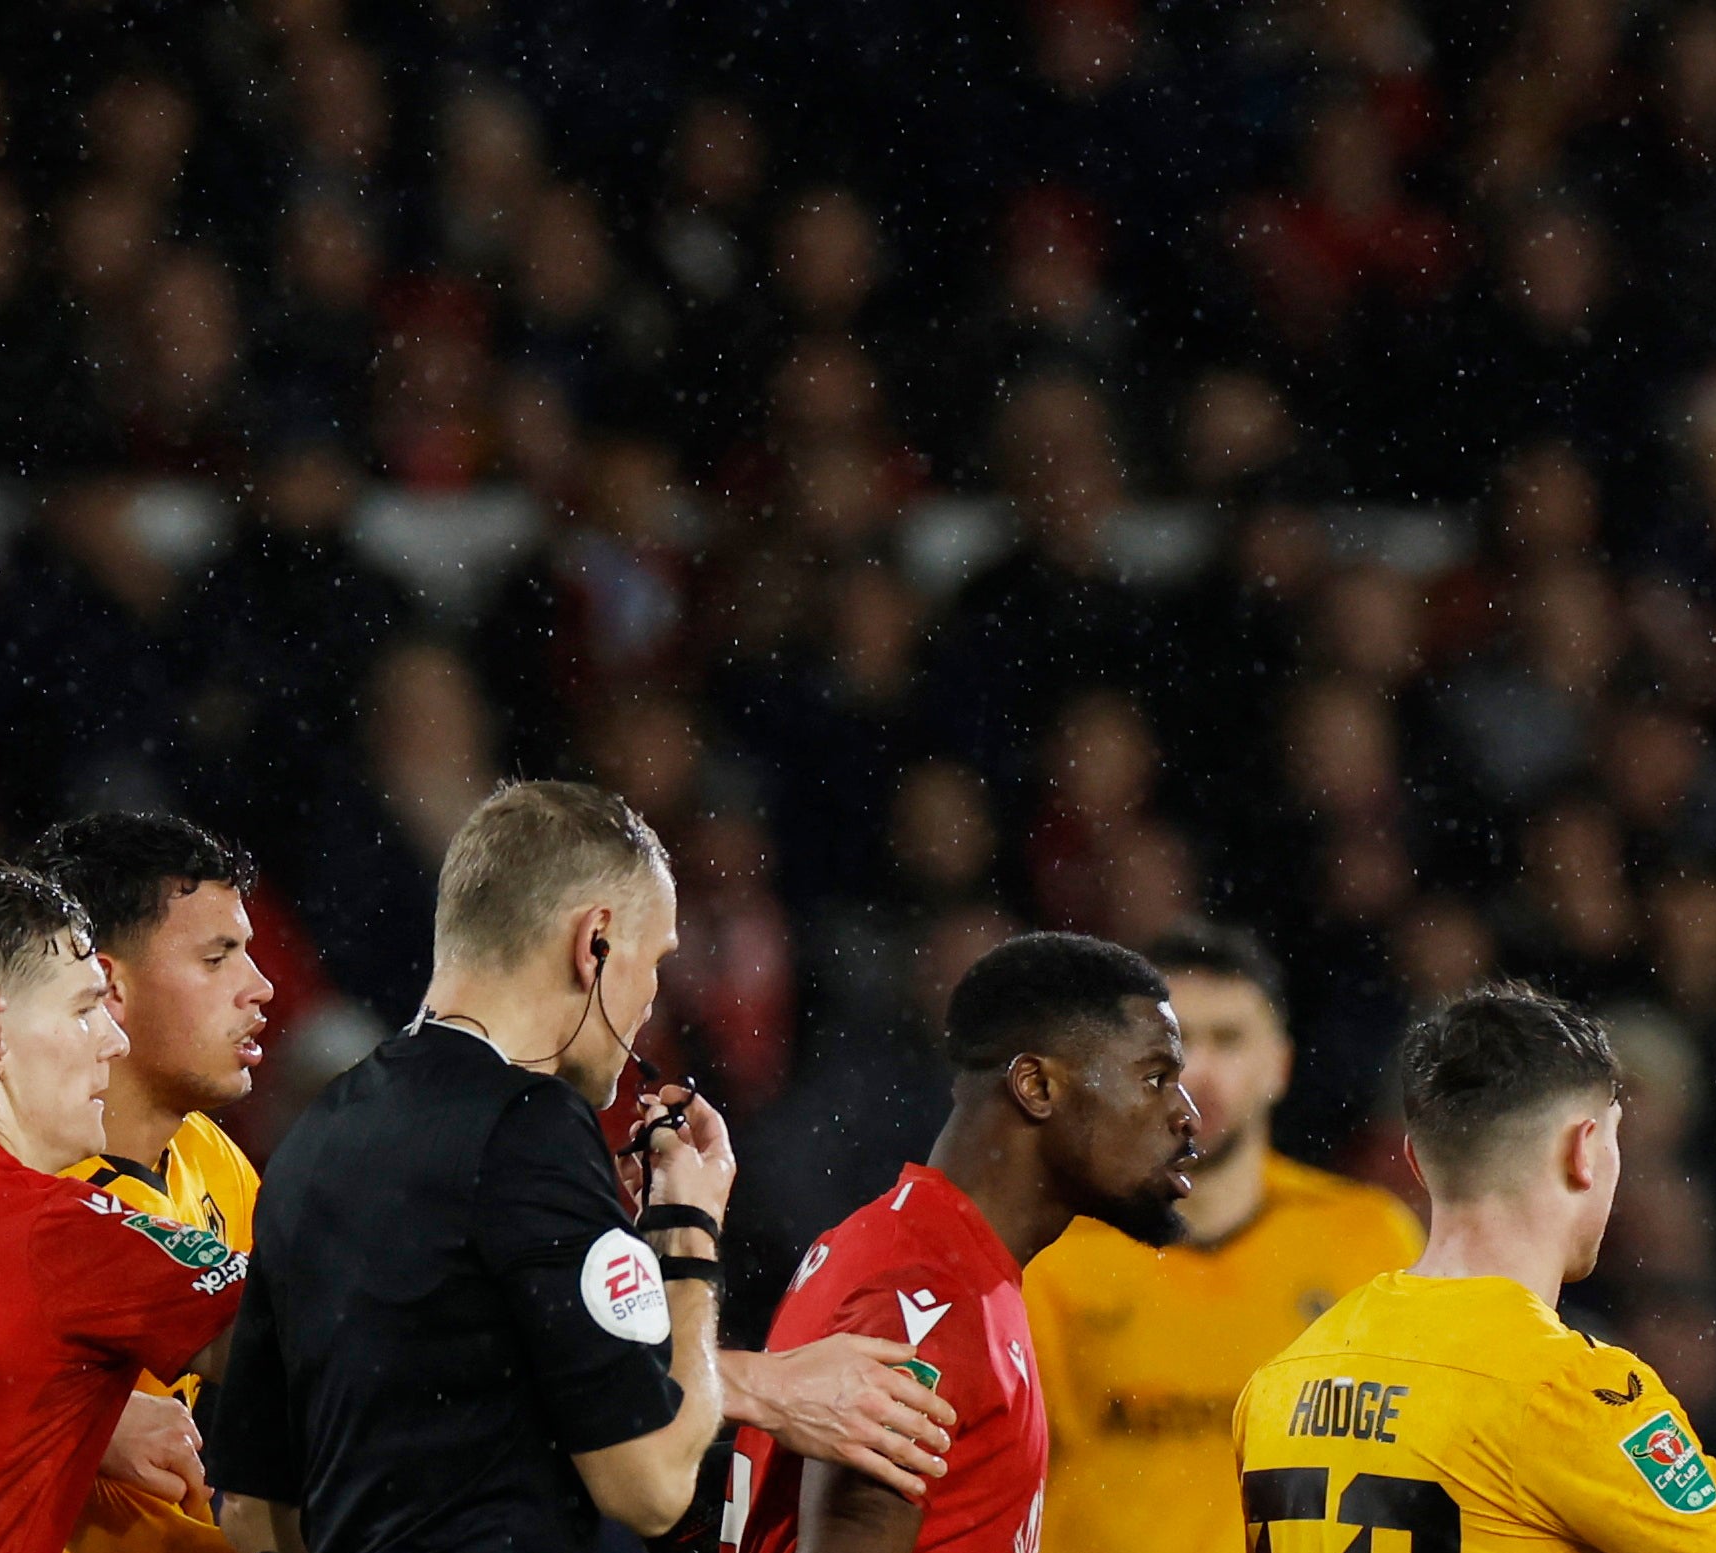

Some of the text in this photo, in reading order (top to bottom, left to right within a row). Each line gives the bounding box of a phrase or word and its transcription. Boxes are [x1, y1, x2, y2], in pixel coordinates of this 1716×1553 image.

[605, 1254, 657, 1301] EA
[611, 1290, 664, 1321] SPORTS
[1289, 1376, 1411, 1444] HODGE
[1655, 1445, 1697, 1490] Carabao
[1675, 1464, 1699, 1488] Cup
